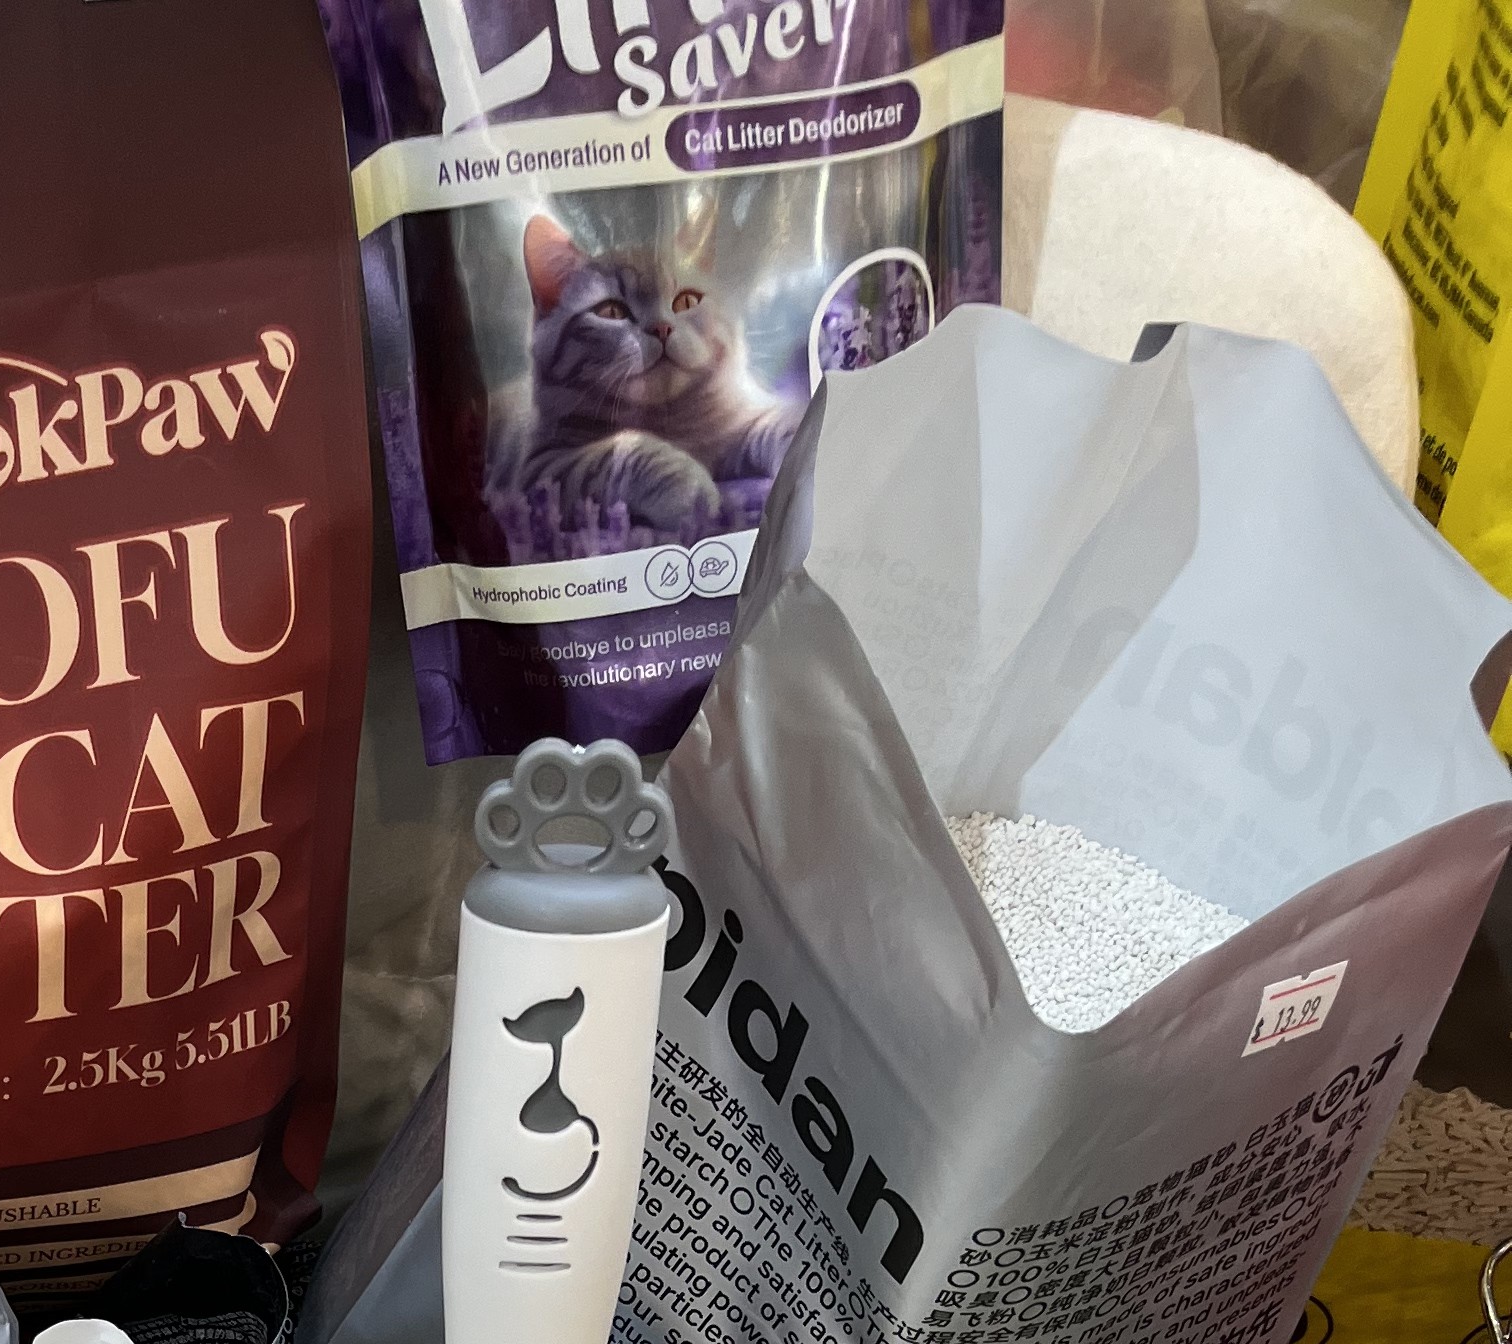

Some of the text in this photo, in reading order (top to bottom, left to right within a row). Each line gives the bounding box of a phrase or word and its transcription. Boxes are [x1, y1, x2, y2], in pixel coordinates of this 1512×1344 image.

[614, 0, 848, 119] Saver
[438, 101, 905, 186] A New Generation of Cat Litter Deodorizer
[472, 577, 628, 605] Hydrophobic Coating
[530, 620, 731, 663] goodbye to unpleasa
[680, 651, 723, 673] new
[42, 1046, 166, 1095] 2.5Kg
[174, 1000, 292, 1072] 5.51LB
[1273, 995, 1323, 1038] 13.99
[650, 1120, 730, 1195] starch
[753, 1207, 793, 1262] The
[797, 1260, 854, 1336] 100%
[1133, 1312, 1156, 1335] is
[1162, 1218, 1321, 1320] characterized
[756, 1174, 795, 1225] Cat
[794, 1219, 849, 1293] Litter
[1079, 1298, 1148, 1344] made
[1154, 1277, 1183, 1304] of
[1184, 1250, 1238, 1290] safe
[1122, 1213, 1279, 1306] Consumables
[662, 1212, 761, 1303] product
[760, 1302, 788, 1331] of
[1202, 1271, 1296, 1343] presents
[712, 1213, 762, 1262] and
[1164, 1305, 1211, 1341] and
